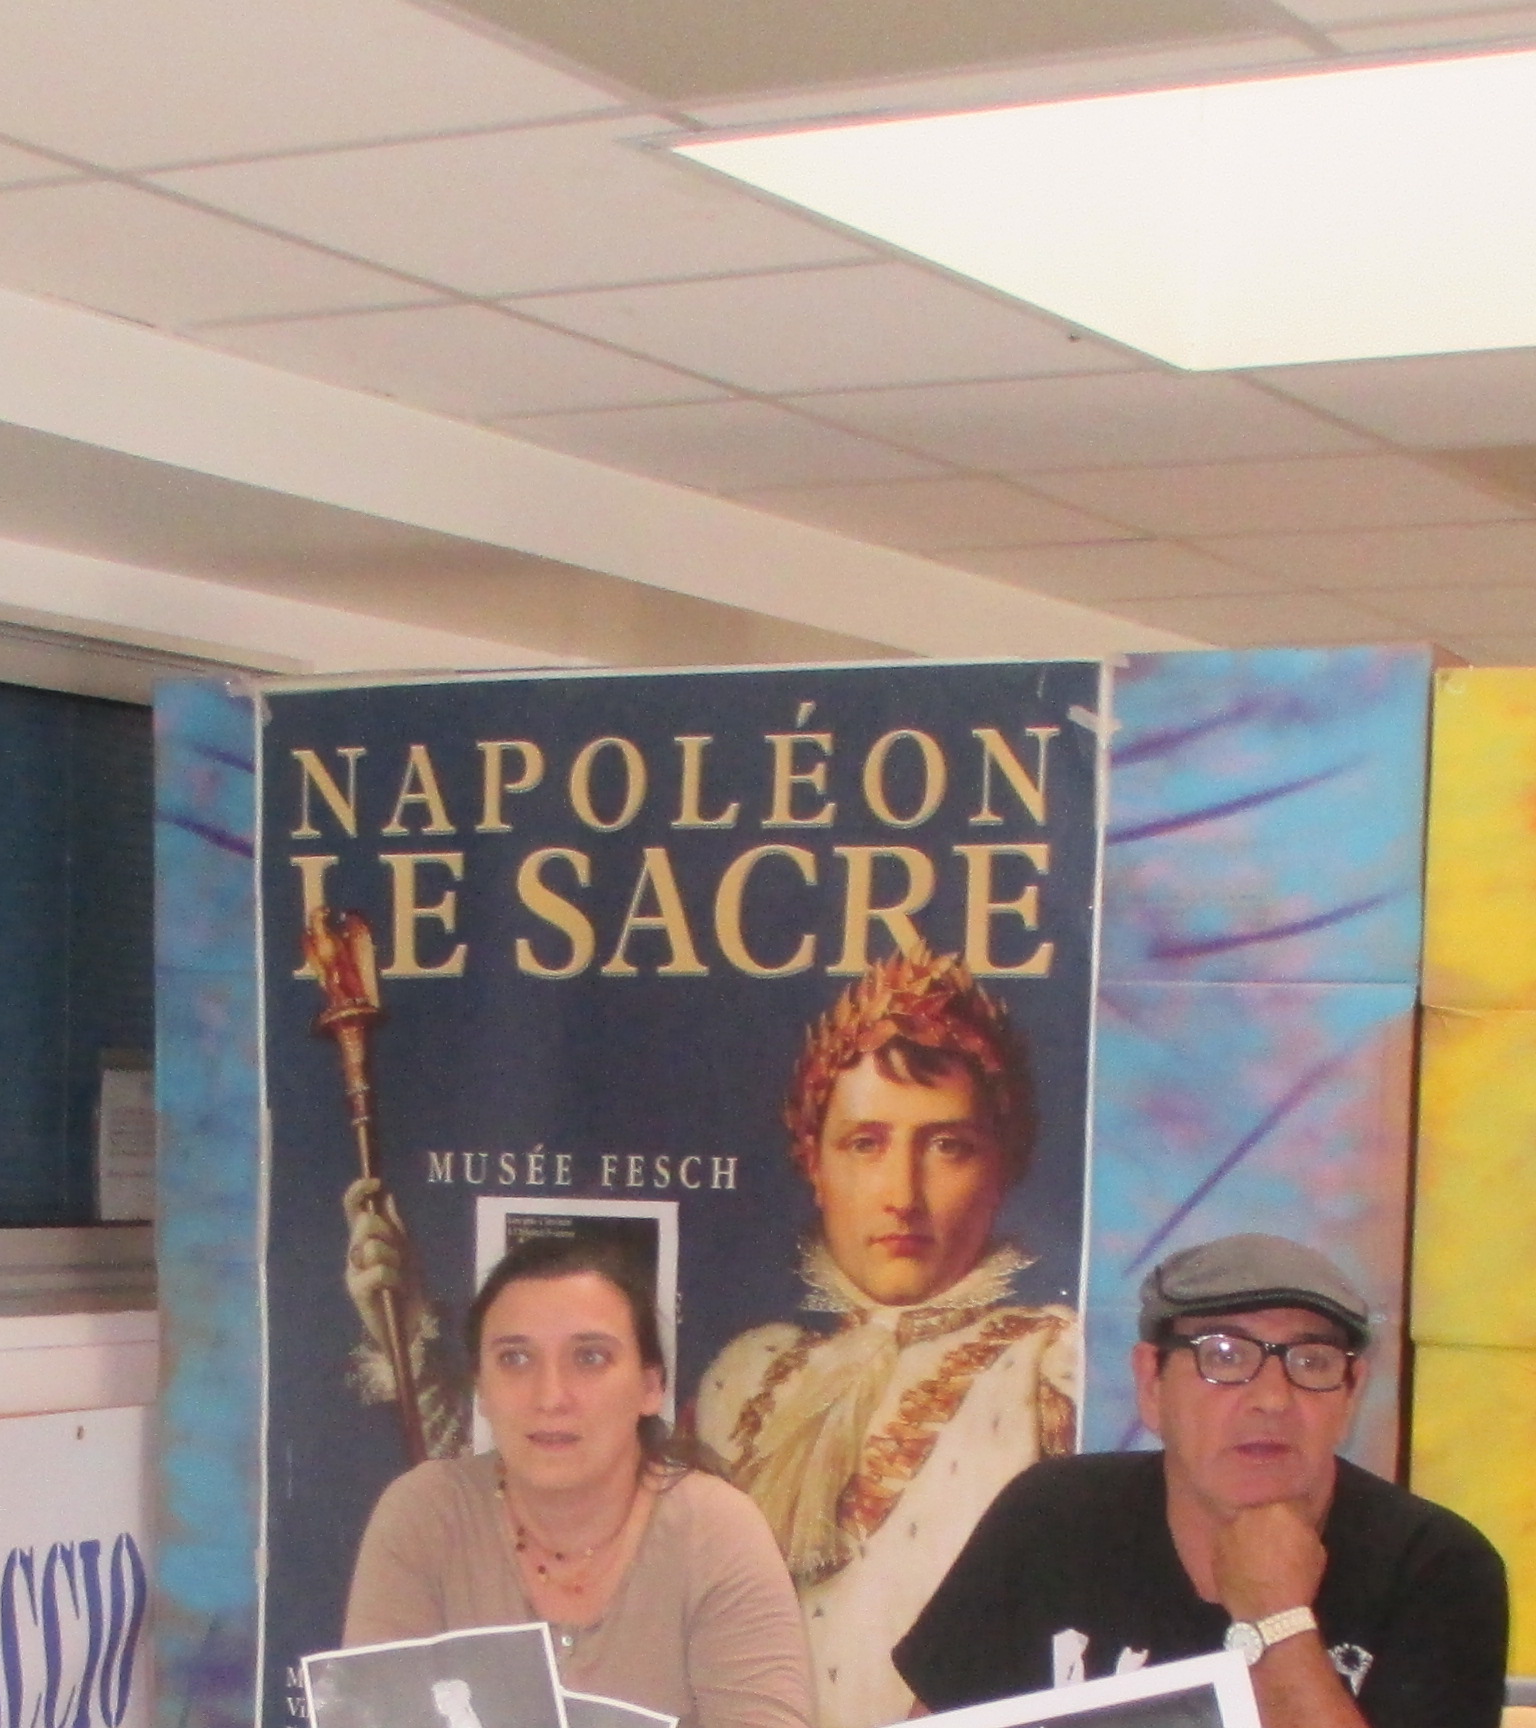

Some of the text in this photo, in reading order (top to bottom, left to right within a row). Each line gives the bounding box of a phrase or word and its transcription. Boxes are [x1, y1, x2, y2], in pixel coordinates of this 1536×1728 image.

[290, 702, 1061, 838] NAPOLÉON
[290, 843, 1055, 979] LE SACRE
[428, 1143, 739, 1190] MUSÉE FESCH
